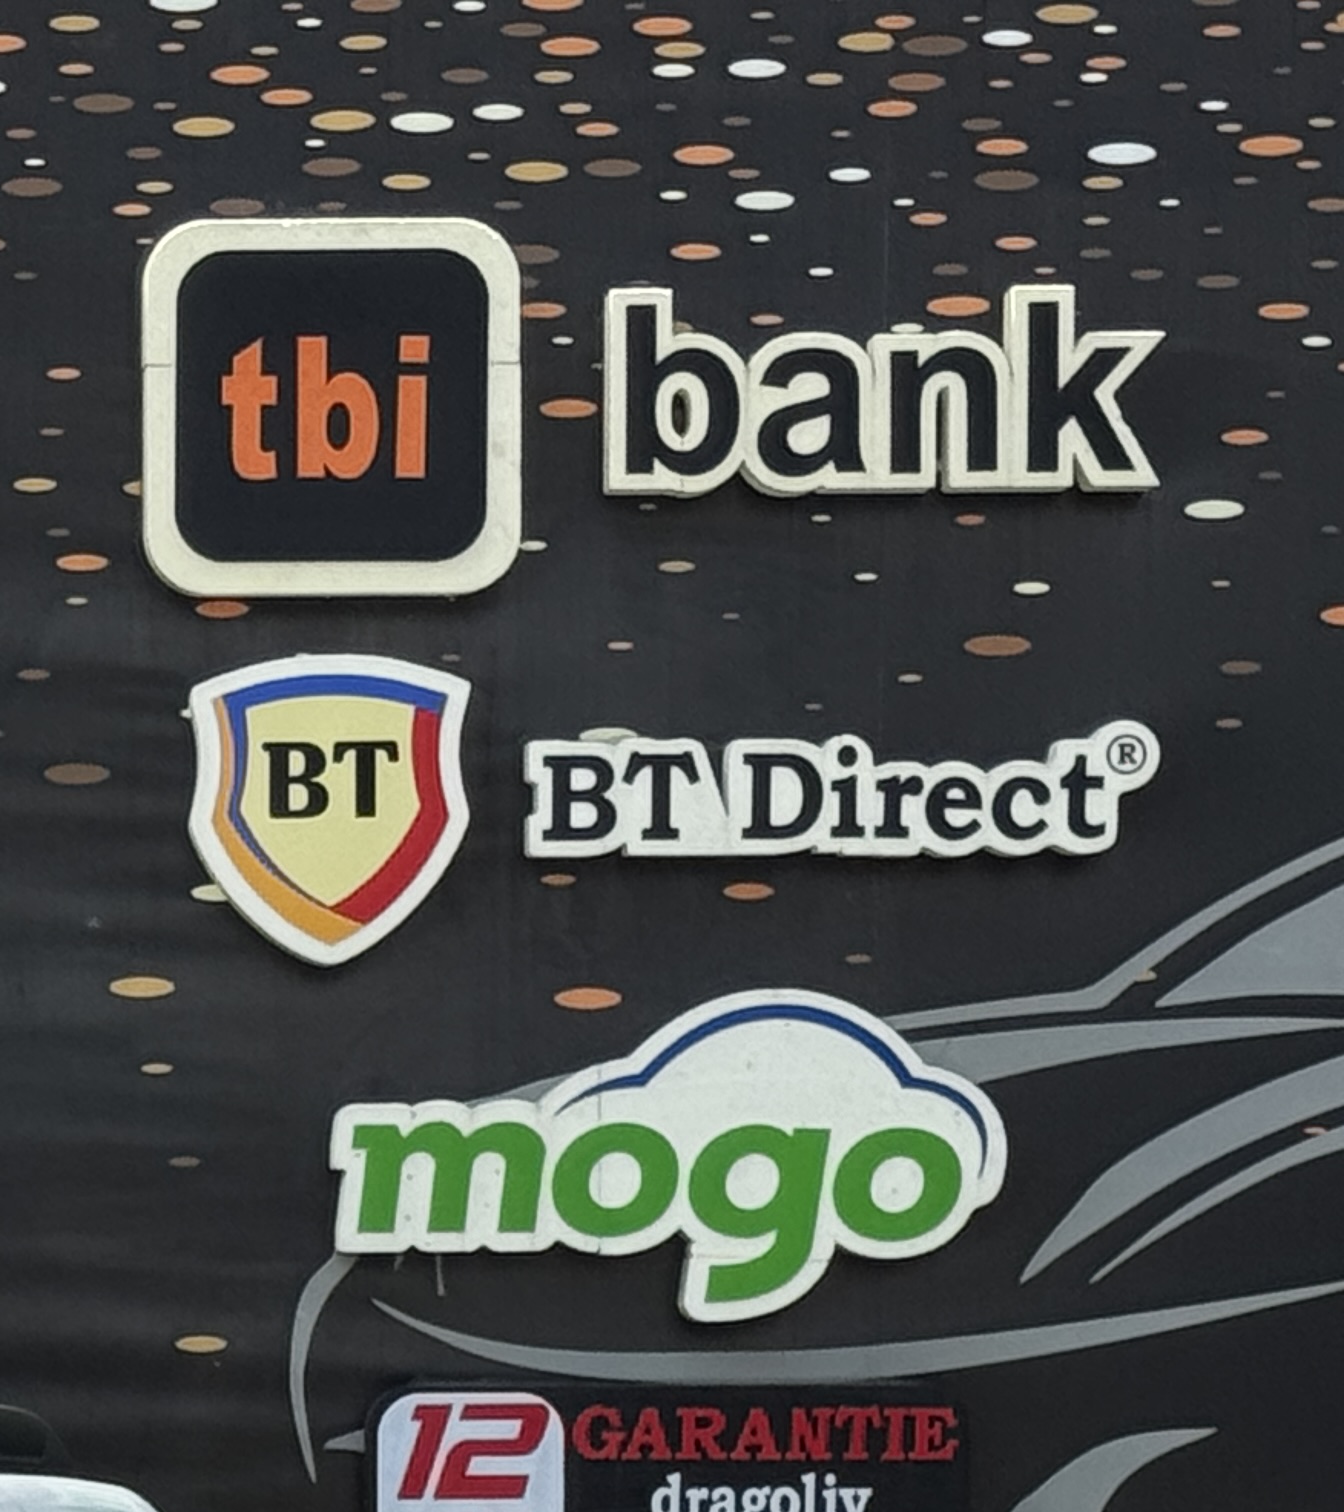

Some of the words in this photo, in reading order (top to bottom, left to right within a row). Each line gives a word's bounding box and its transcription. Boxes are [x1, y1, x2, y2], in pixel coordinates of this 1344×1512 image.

[220, 334, 432, 481] tbi
[610, 288, 1160, 490] bank
[261, 739, 399, 819] BT
[541, 752, 701, 842] BT
[352, 1120, 962, 1303] mogo
[397, 1403, 551, 1499] 12
[571, 1405, 960, 1463] GARANTIE
